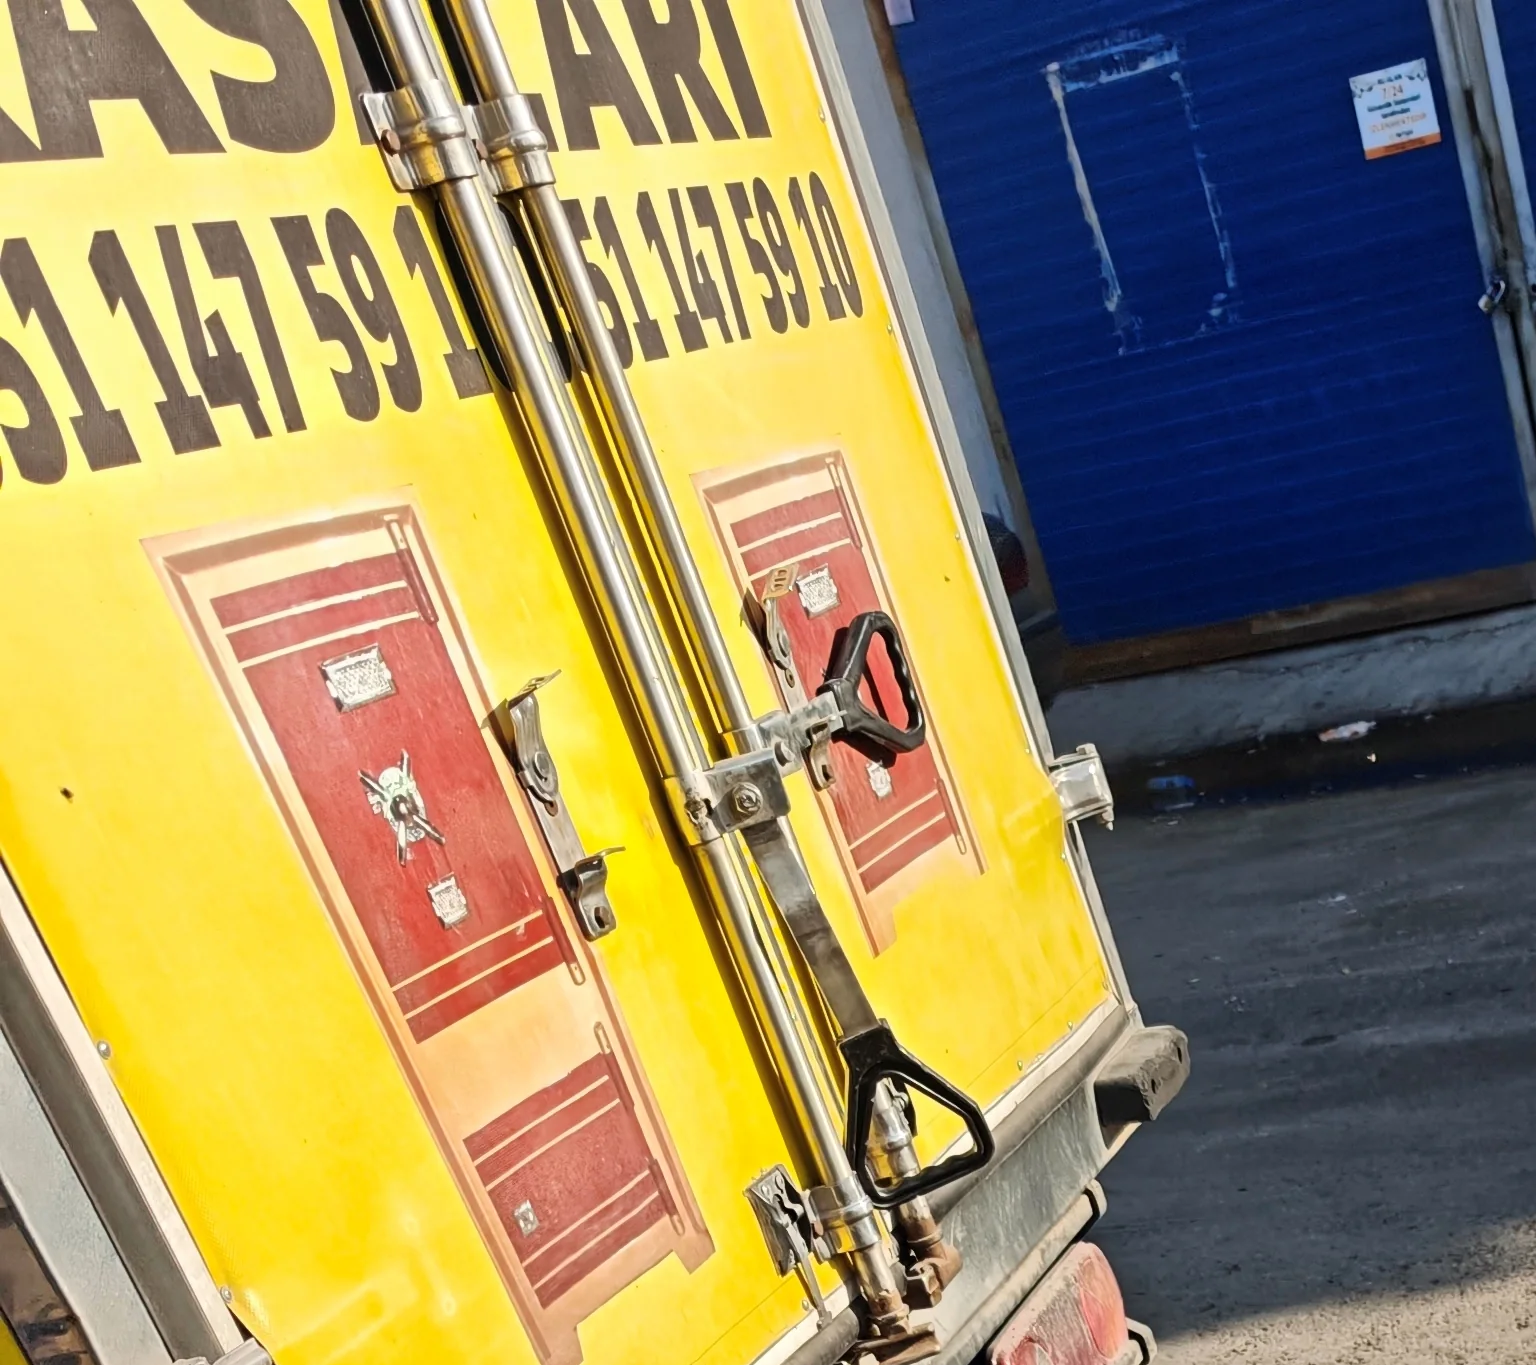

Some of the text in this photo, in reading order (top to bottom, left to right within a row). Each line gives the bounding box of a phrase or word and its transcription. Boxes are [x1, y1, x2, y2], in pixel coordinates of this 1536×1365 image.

[0, 236, 142, 487] 51
[88, 219, 308, 455] 147
[270, 207, 422, 422] 59
[636, 185, 752, 354] 147
[724, 176, 811, 334] 59
[788, 171, 863, 322] 10
